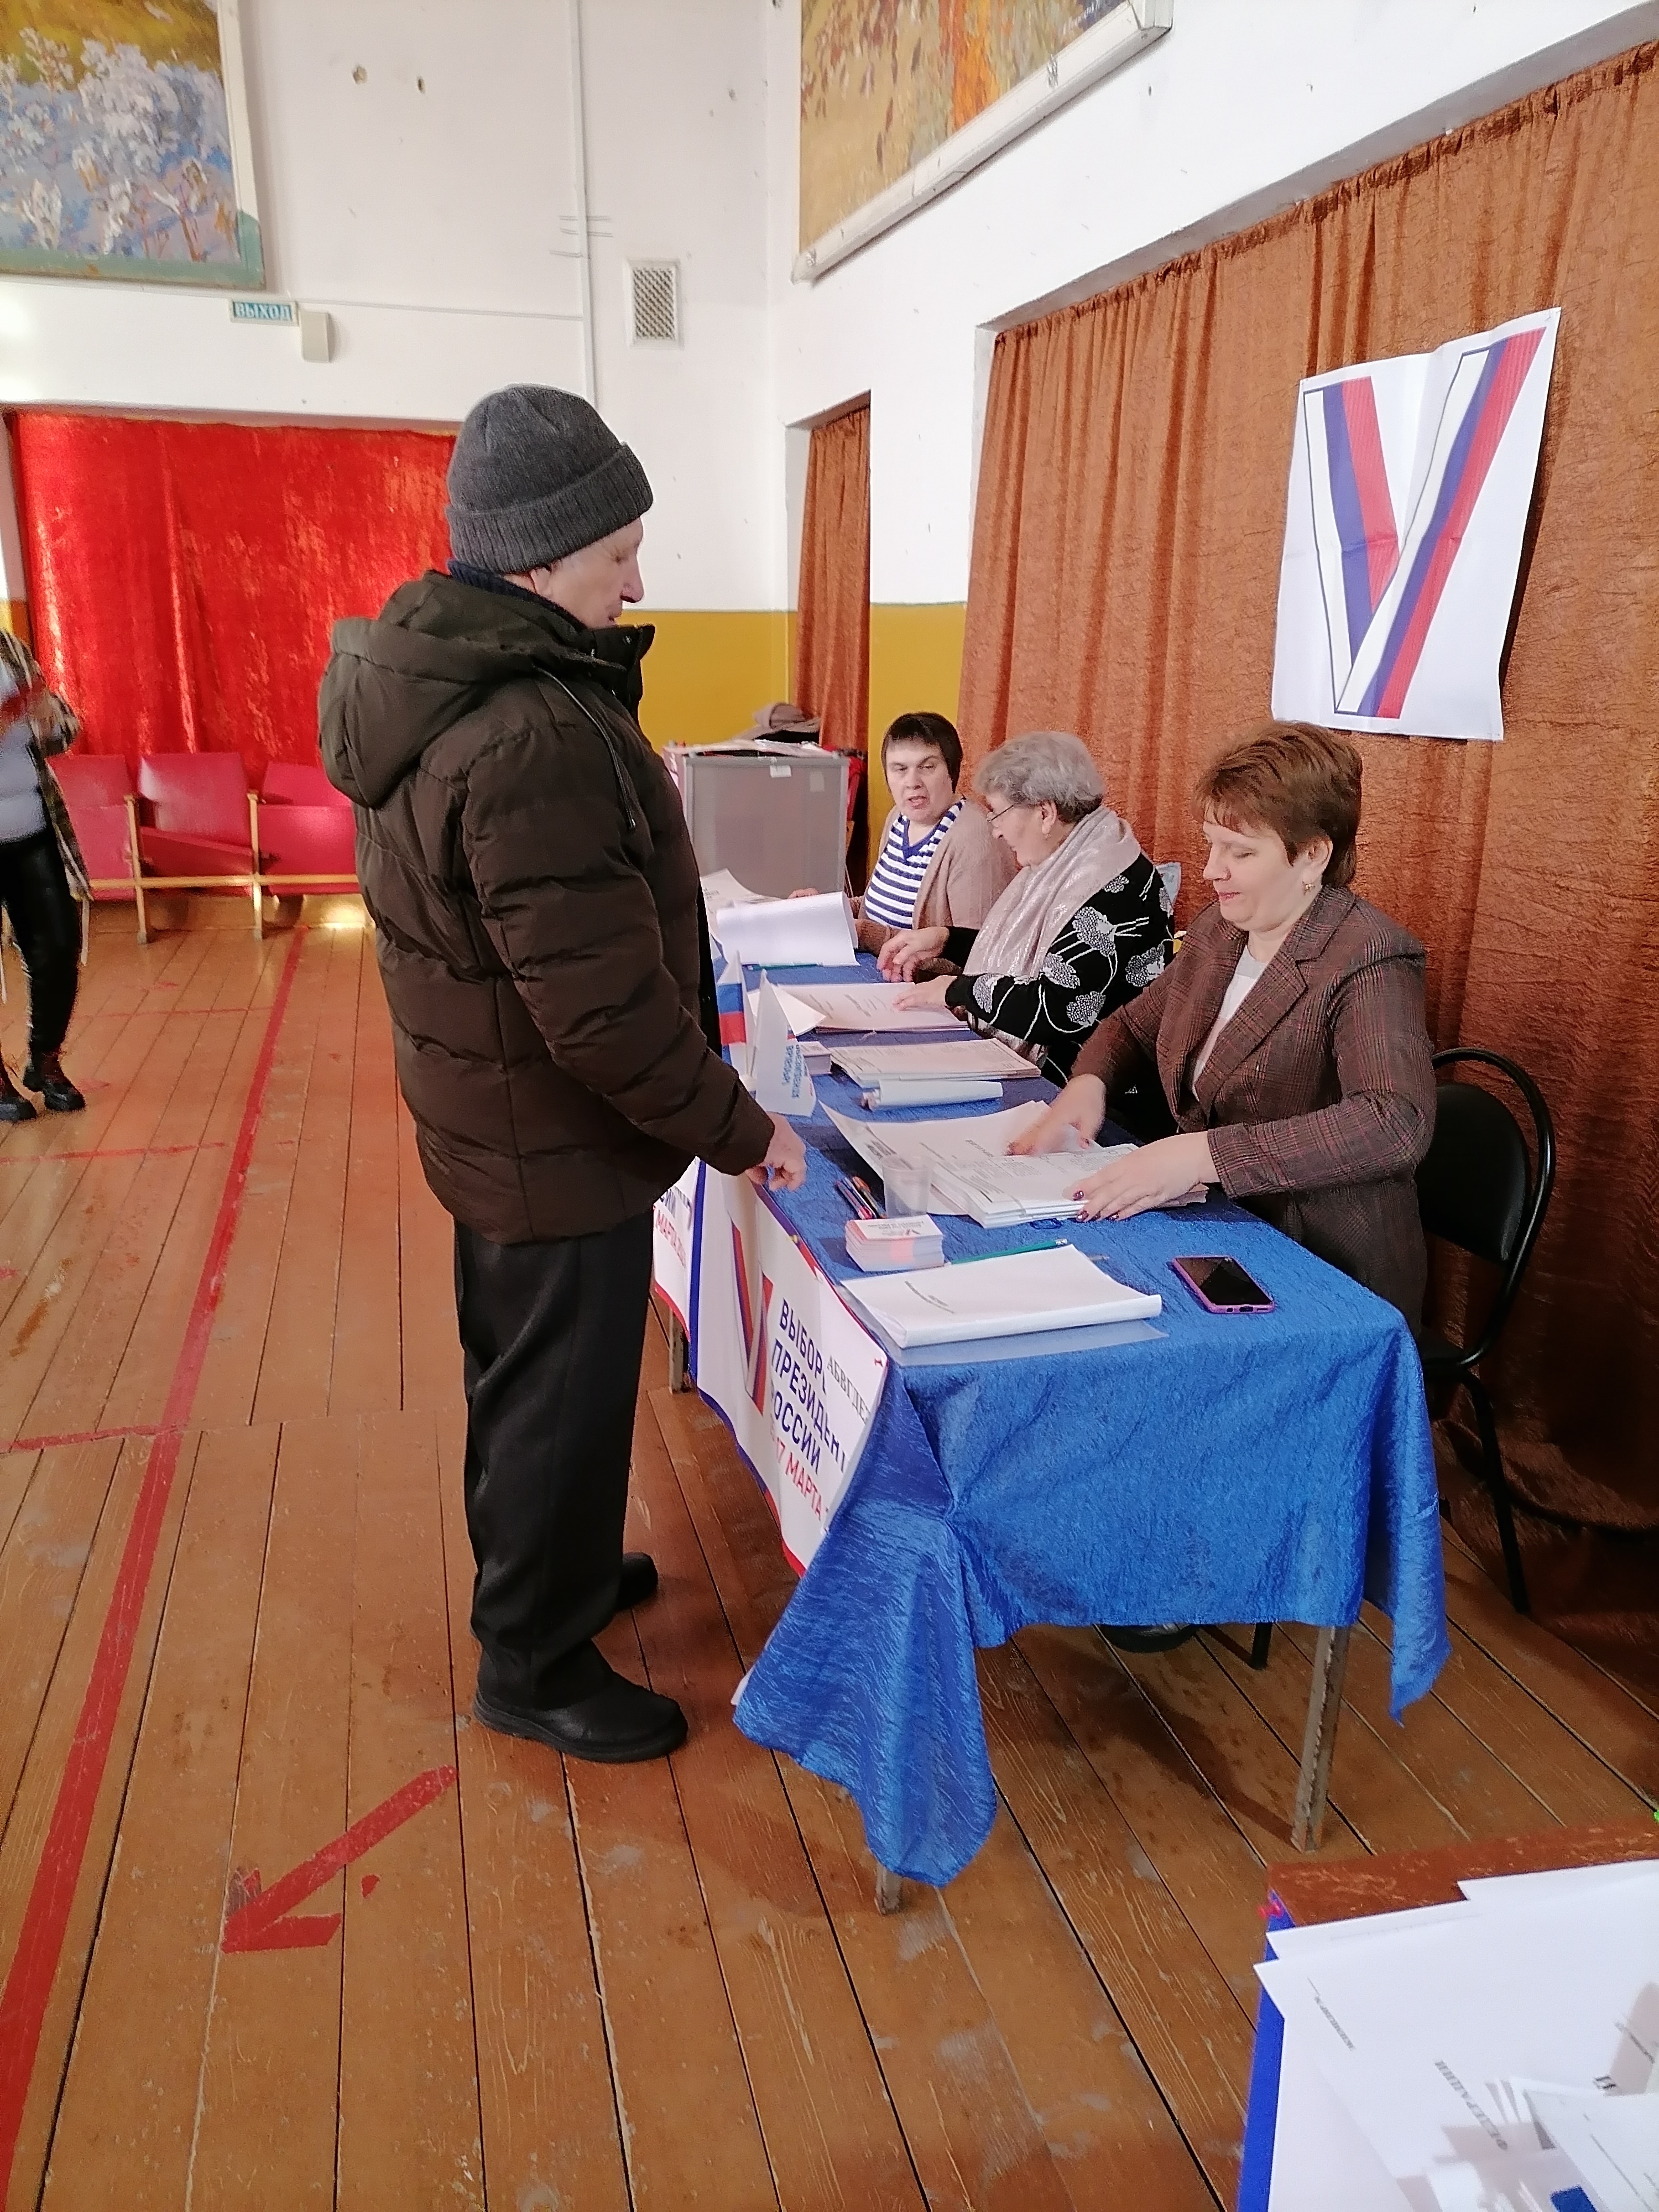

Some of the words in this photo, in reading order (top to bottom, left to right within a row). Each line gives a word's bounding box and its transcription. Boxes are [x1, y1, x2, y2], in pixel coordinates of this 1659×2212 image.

[234, 302, 291, 321] ВЫХОД
[779, 1297, 826, 1395] ВЫБОР
[774, 1390, 820, 1475] ОССИИ
[785, 1452, 822, 1521] МАРТА
